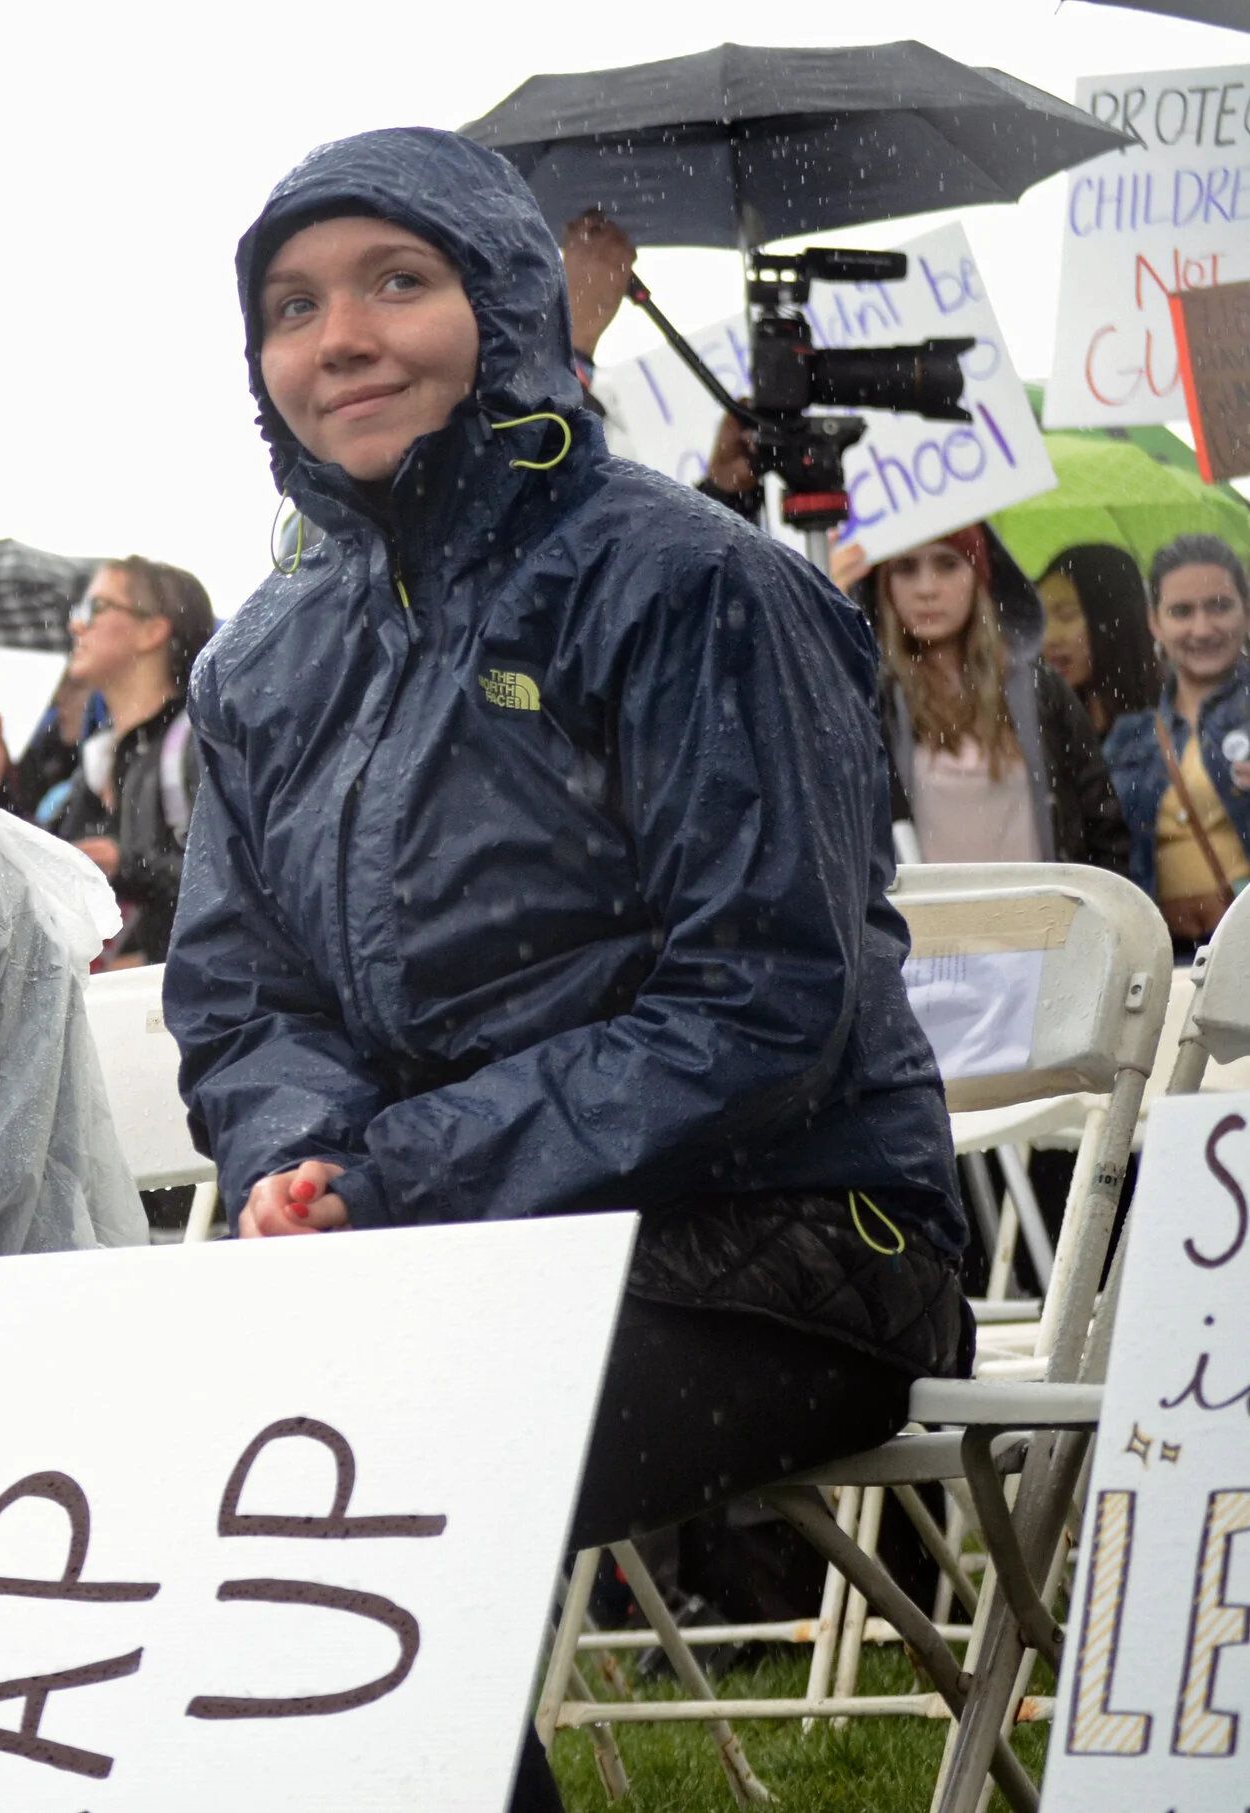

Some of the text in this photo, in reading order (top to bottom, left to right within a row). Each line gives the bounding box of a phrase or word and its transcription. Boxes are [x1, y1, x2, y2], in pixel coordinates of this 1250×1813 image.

[1091, 82, 1250, 155] PROTE
[918, 254, 987, 315] be
[478, 674, 516, 697] NORTH
[490, 669, 516, 685] THE
[486, 690, 516, 709] FACE
[185, 1416, 447, 1720] UP
